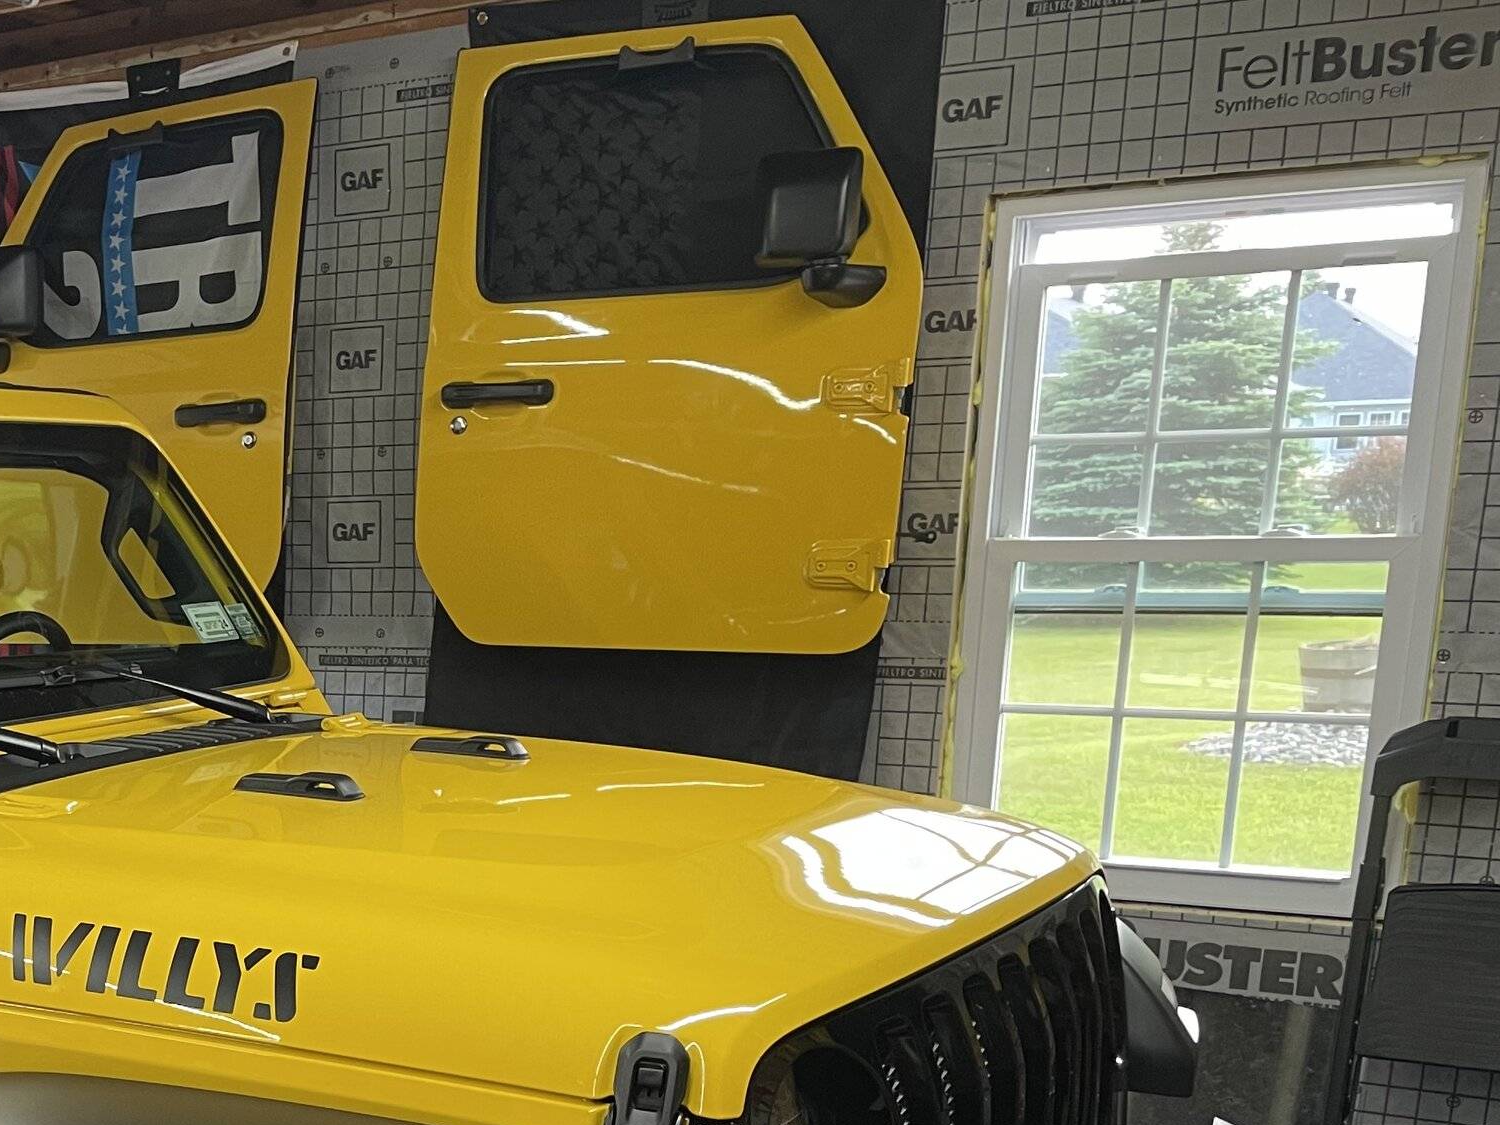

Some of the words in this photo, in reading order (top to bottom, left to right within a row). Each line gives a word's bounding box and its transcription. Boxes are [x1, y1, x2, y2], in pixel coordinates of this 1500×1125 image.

[1216, 25, 1500, 93] FeltBuster
[941, 95, 1004, 124] GAF
[1214, 93, 1299, 117] Synthetic
[1304, 86, 1375, 106] Roofing
[1379, 81, 1413, 99] Felt
[340, 169, 384, 192] GAF
[335, 348, 378, 371] GAF
[332, 522, 376, 541] GAF
[12, 912, 320, 1023] WILLYS
